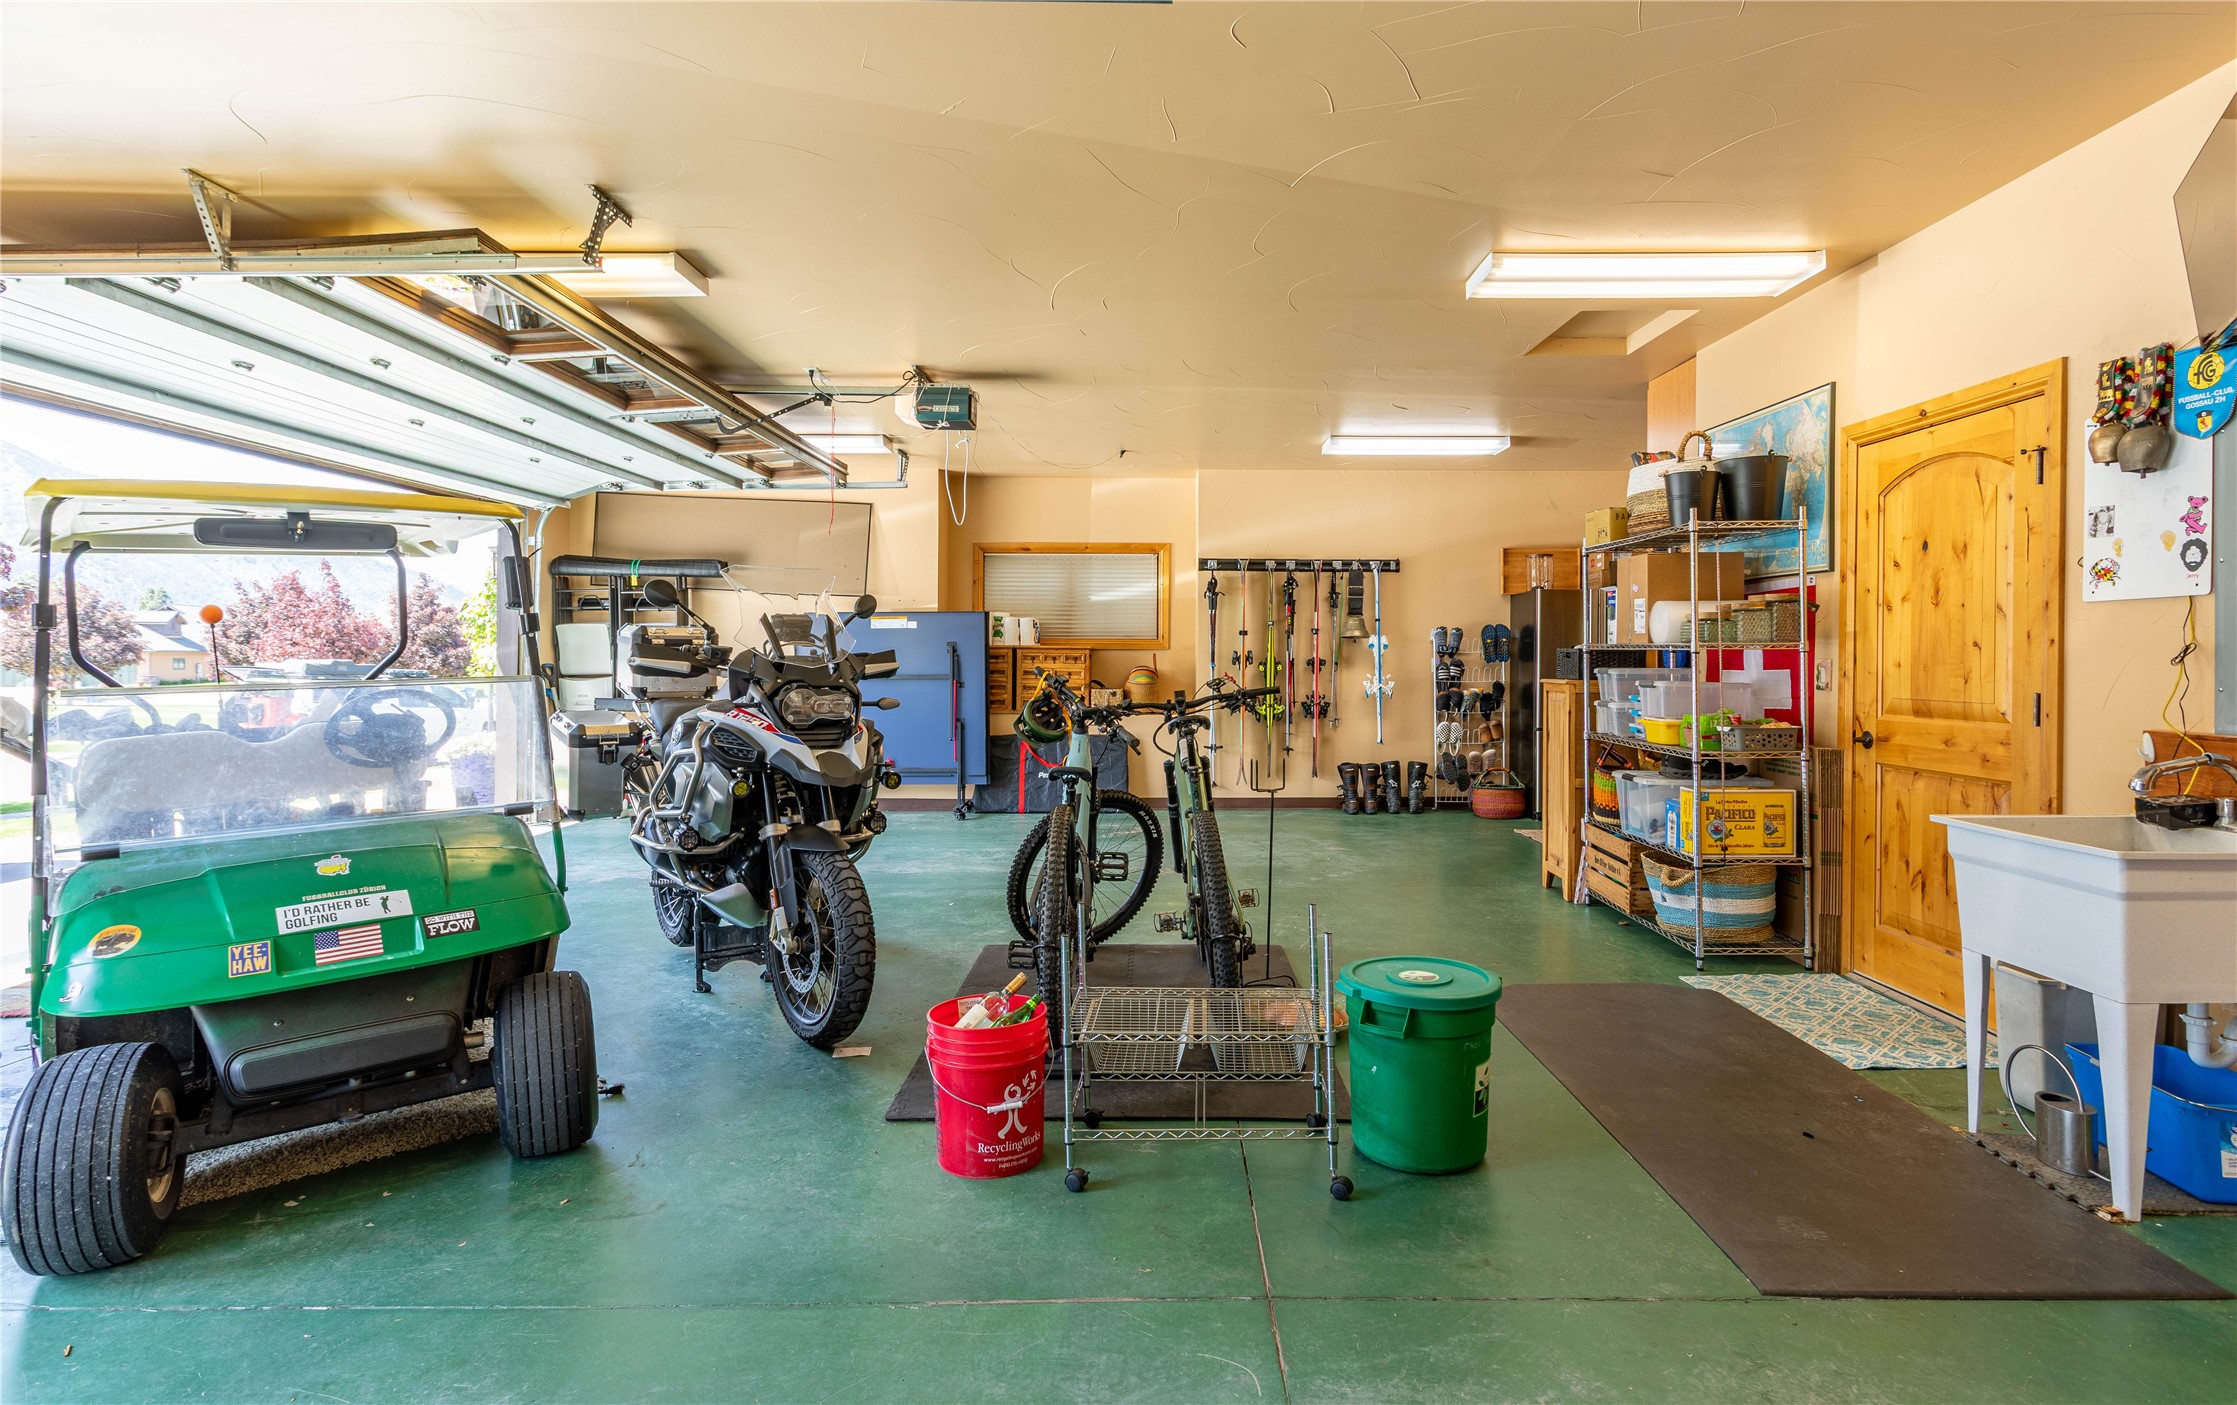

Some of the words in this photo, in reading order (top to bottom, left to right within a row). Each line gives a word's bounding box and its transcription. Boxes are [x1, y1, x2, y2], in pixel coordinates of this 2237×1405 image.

[2185, 398, 2214, 410] GOSSAU
[2214, 396, 2226, 404] ZH
[1138, 810, 1158, 838] MAXXIS
[1734, 823, 1756, 831] CLARA
[283, 906, 301, 919] I'D
[304, 899, 352, 915] RATHER
[355, 897, 371, 908] BE
[426, 916, 437, 924] GO
[437, 913, 458, 921] WITH
[459, 910, 473, 918] THE
[284, 912, 338, 930] GOLFING
[427, 917, 475, 936] FLOW
[232, 943, 267, 960] YEE-
[232, 955, 267, 975] HAW
